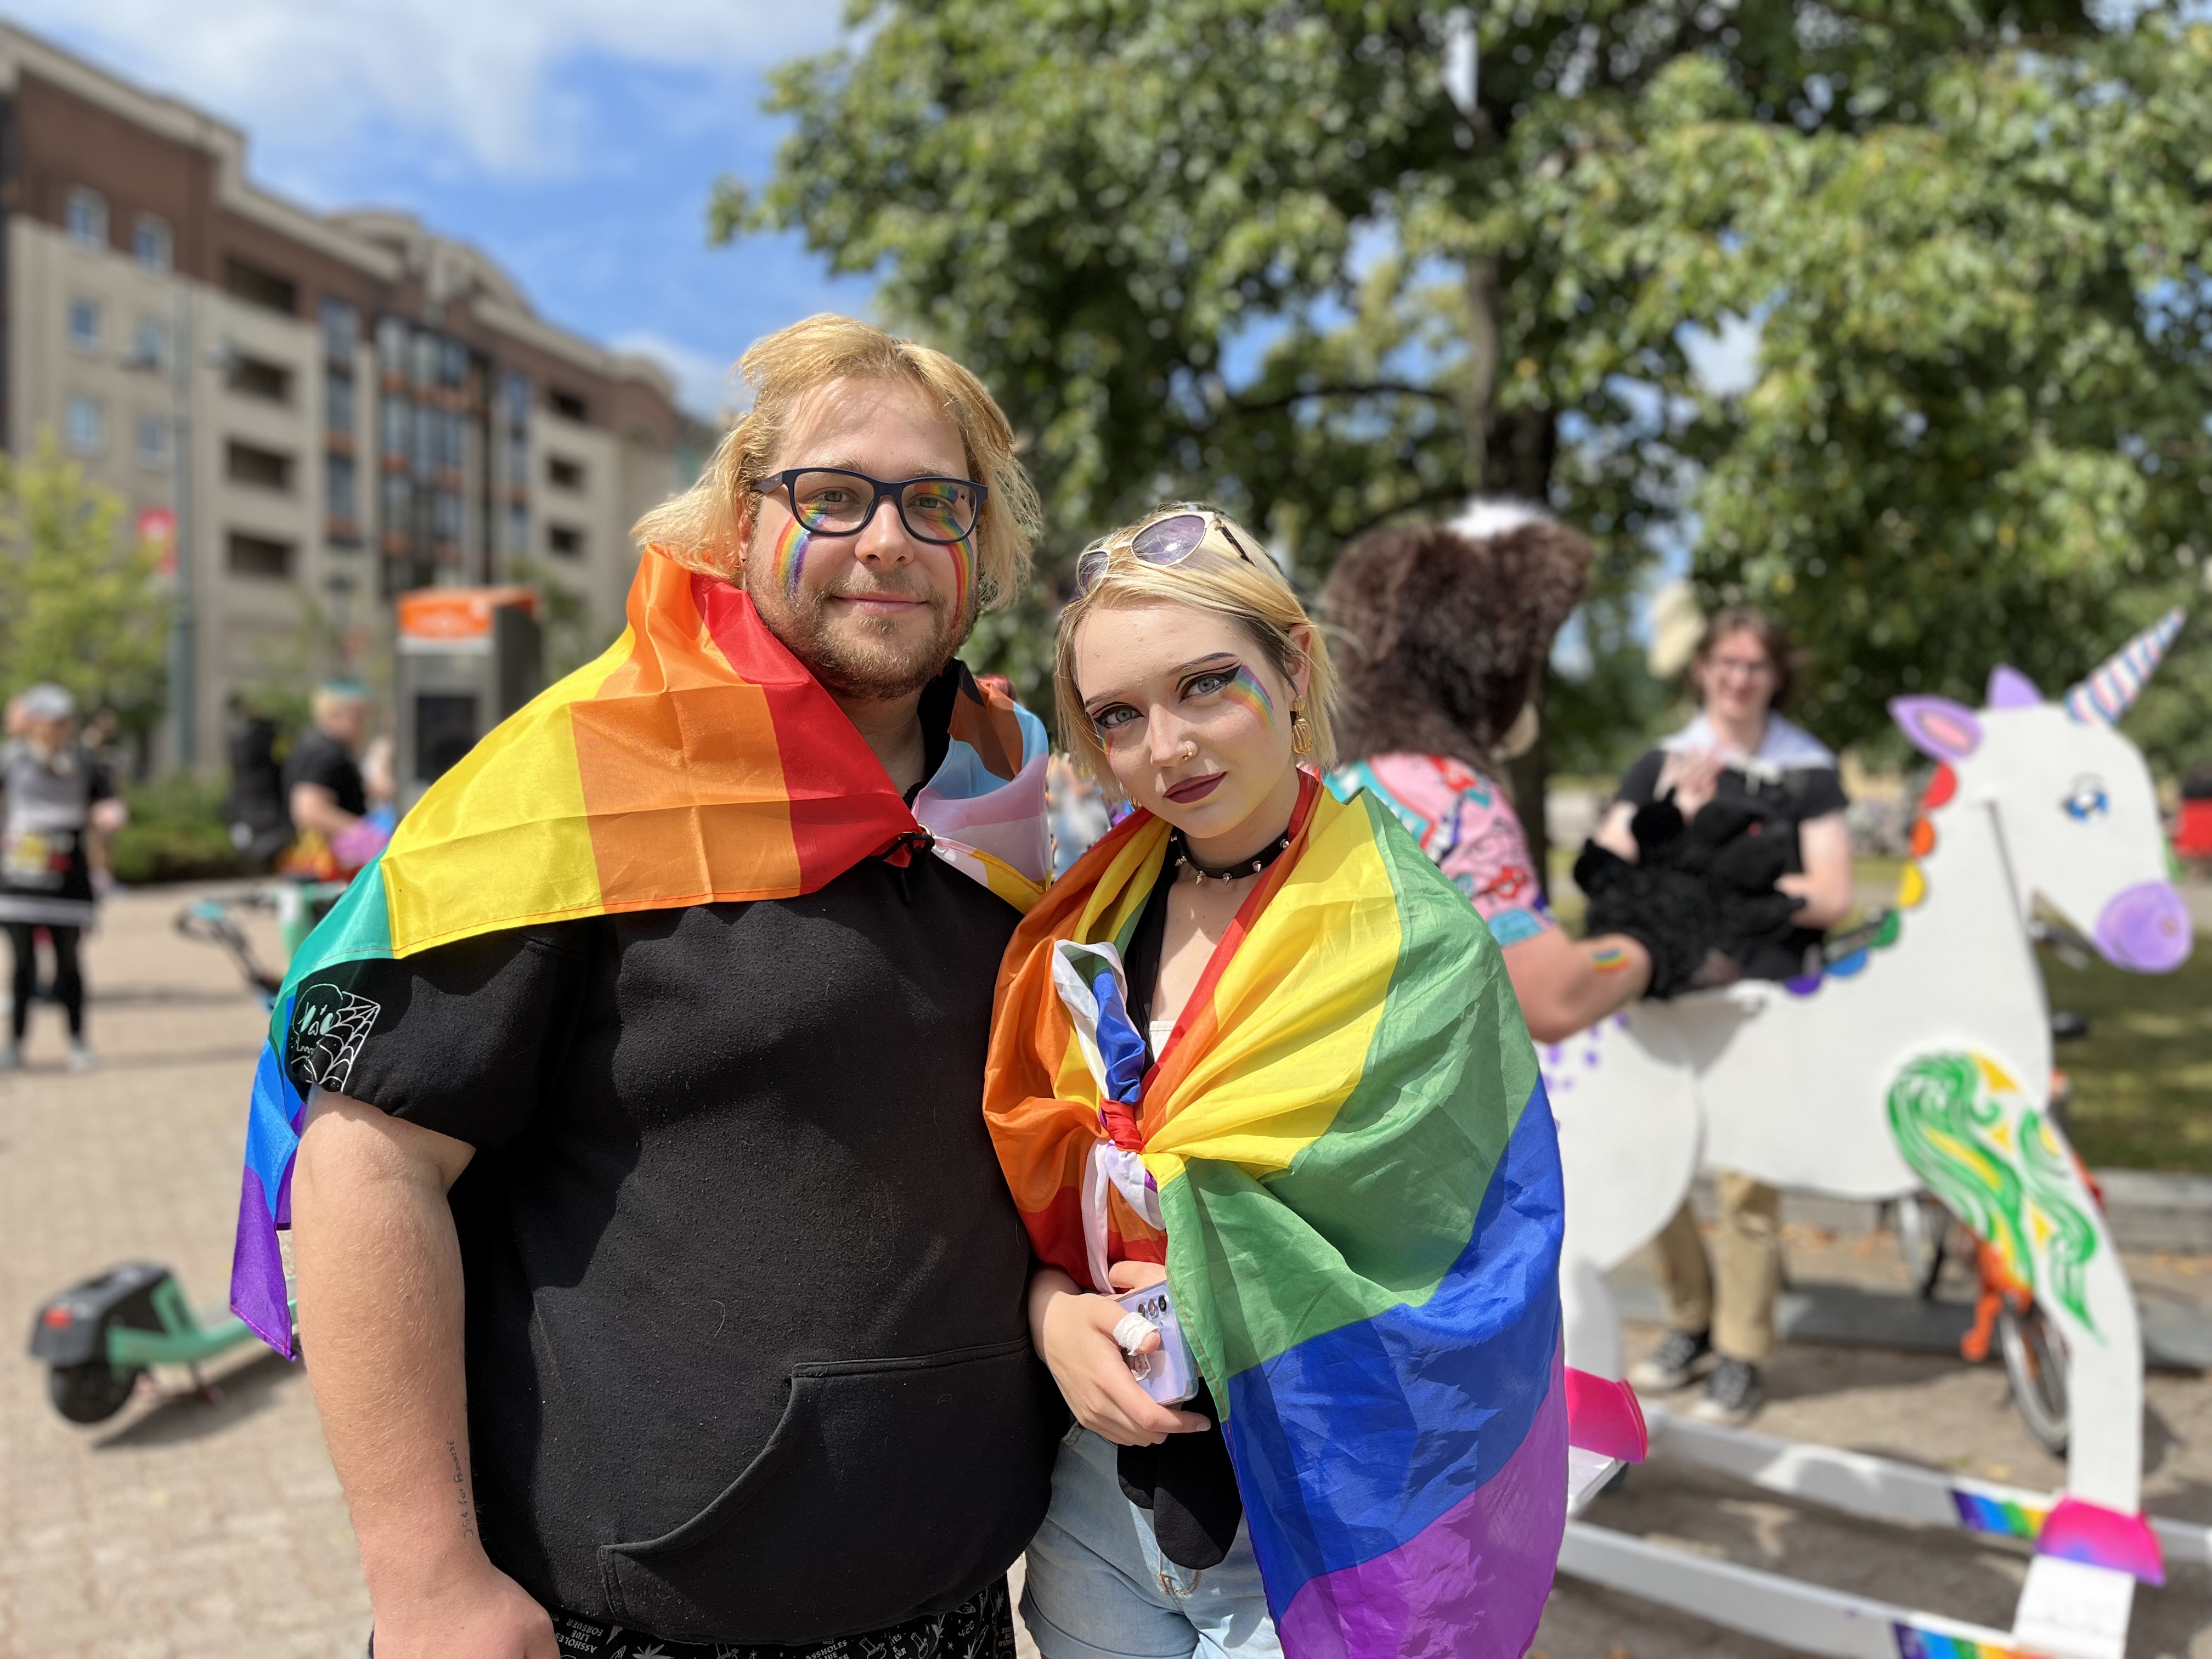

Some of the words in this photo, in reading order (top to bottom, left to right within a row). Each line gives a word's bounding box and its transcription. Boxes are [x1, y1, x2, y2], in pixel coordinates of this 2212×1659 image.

[566, 1618, 604, 1637] FOREVER
[571, 1629, 590, 1642] LIVE
[555, 1633, 598, 1654] ASSHOLES
